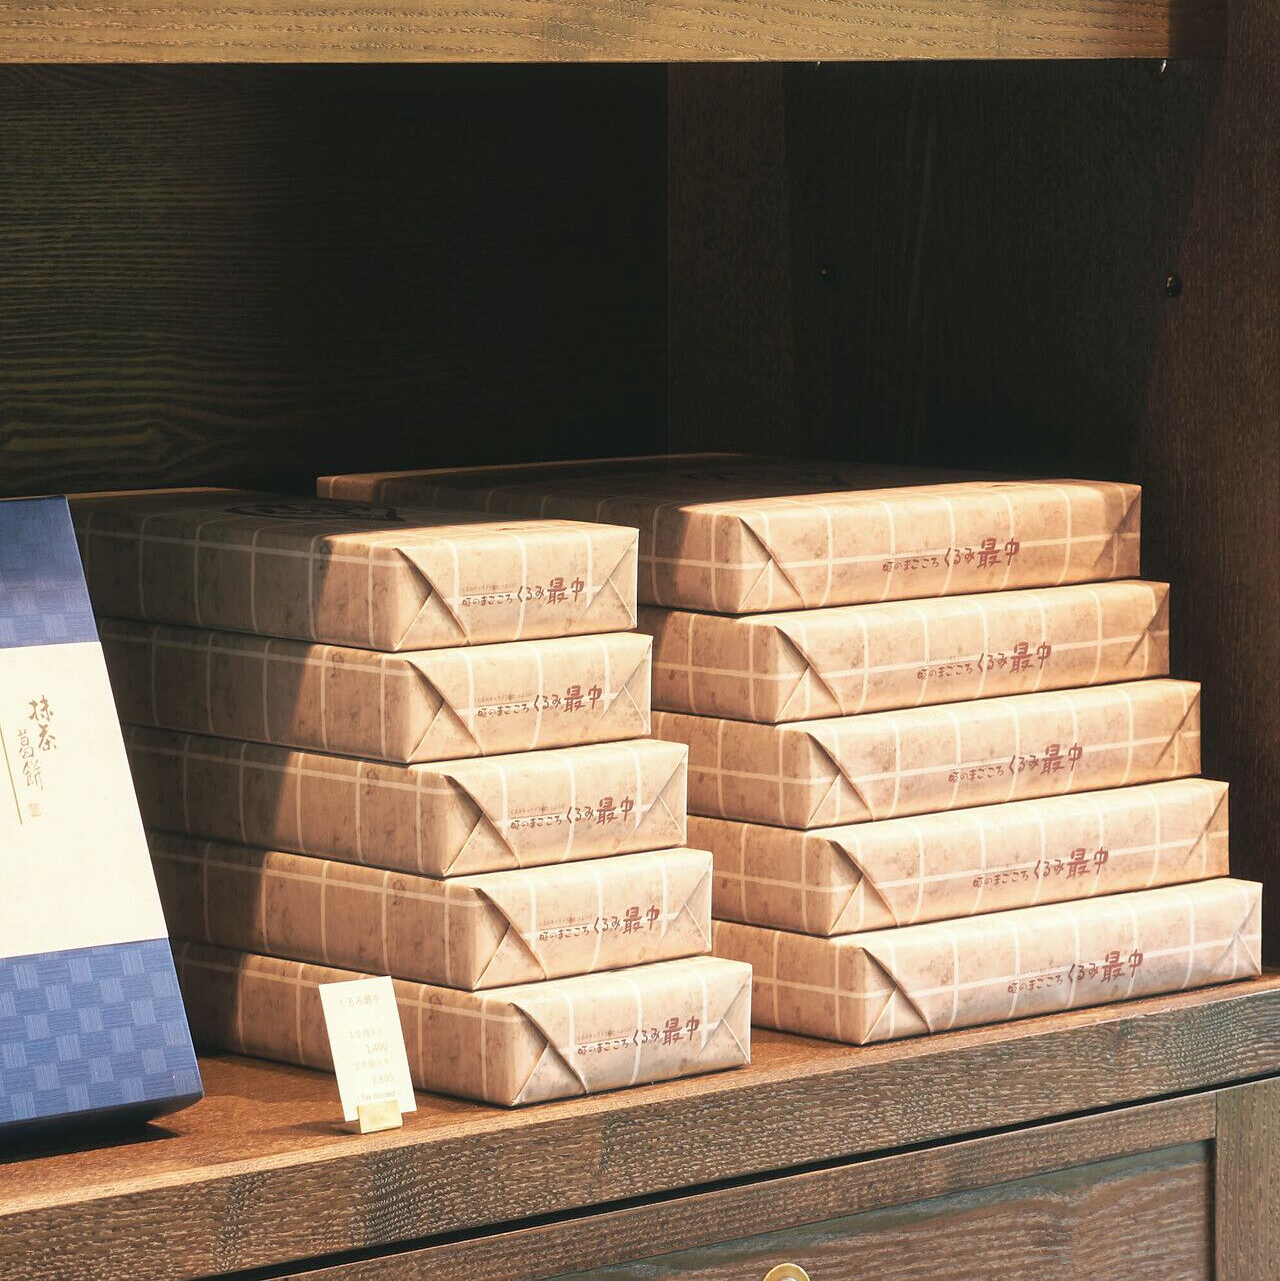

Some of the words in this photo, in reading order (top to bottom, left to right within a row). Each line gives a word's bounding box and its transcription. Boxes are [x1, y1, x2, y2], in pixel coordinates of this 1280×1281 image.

[944, 537, 1020, 569] くるみ最中
[517, 577, 585, 605] くるみ最中
[977, 641, 1052, 673] くるみ最中
[533, 684, 602, 713] くるみ最中
[28, 694, 57, 751] 抹茶
[1008, 743, 1083, 775] くるみ最中
[566, 796, 634, 825] くるみ最中
[1033, 846, 1109, 880] くるみ最中
[593, 904, 660, 935] くるみ最中
[1068, 949, 1144, 983] くるみ最中
[632, 1015, 700, 1046] くるみ最中
